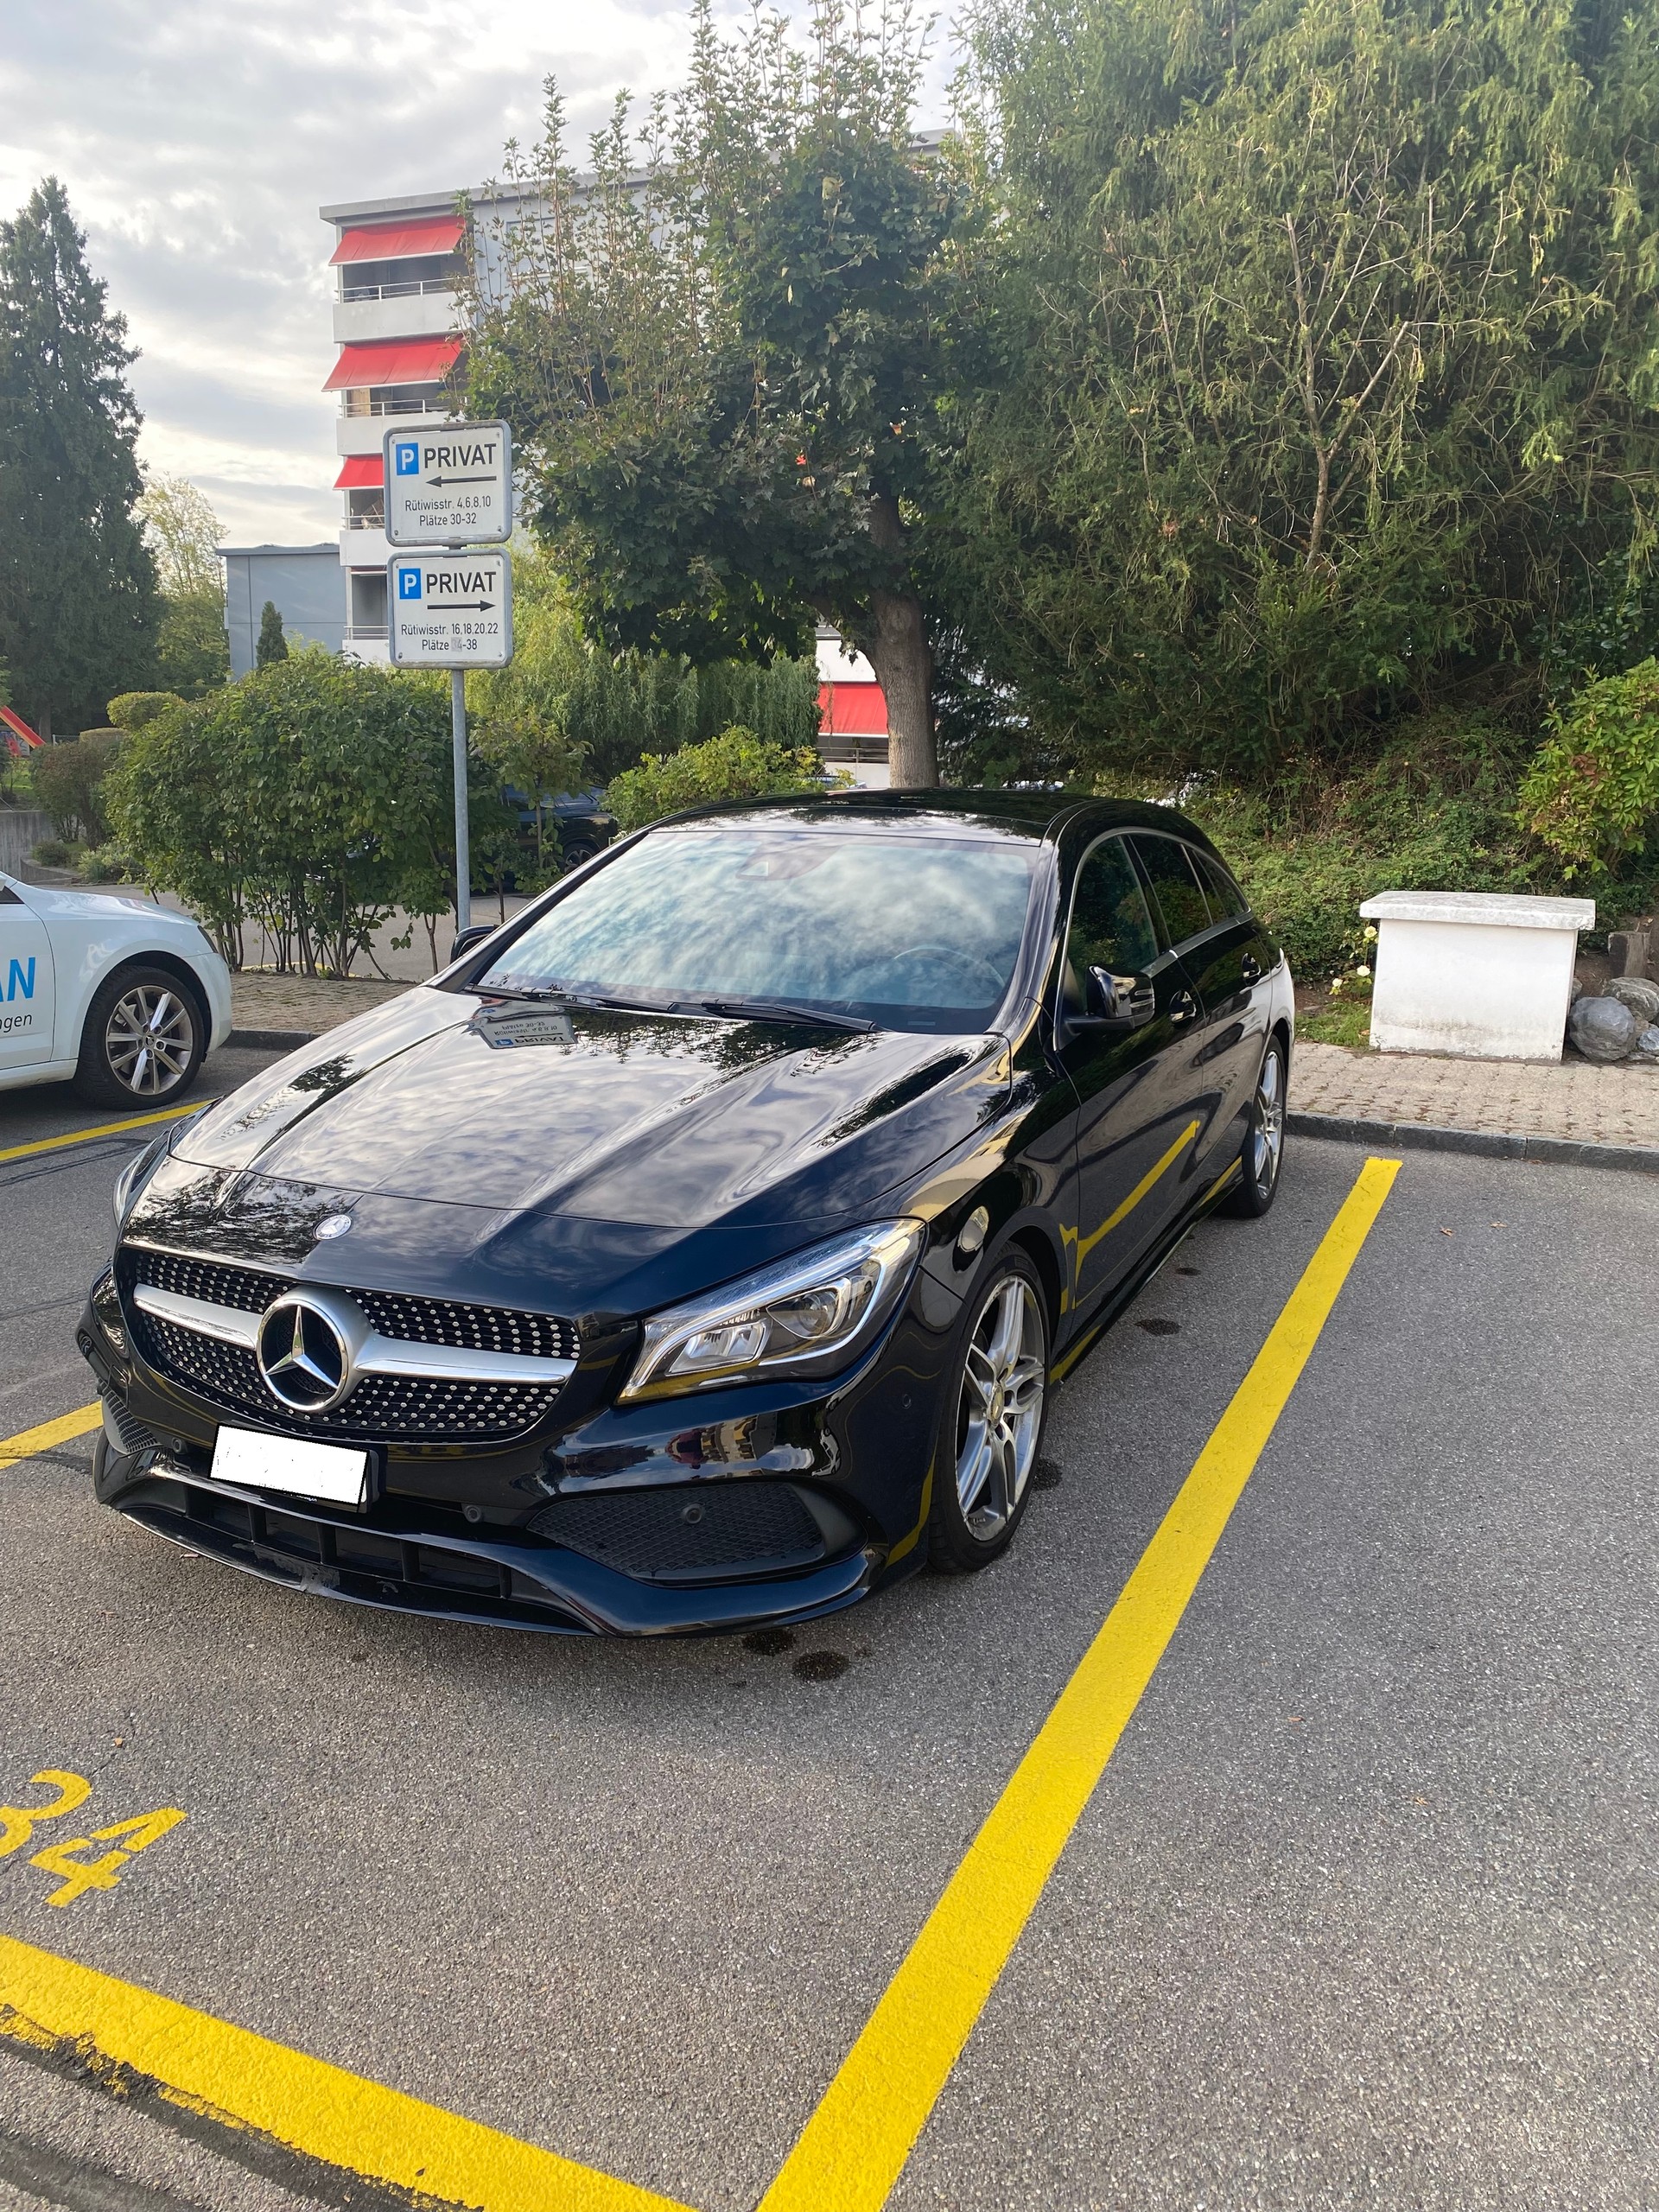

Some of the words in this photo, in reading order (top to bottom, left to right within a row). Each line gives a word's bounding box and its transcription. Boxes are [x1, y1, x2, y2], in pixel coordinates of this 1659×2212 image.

[401, 448, 415, 471] P
[424, 443, 497, 468] PRIVAT
[405, 499, 454, 512] Rütiwisstr.
[457, 495, 491, 509] 4,6,8,10
[419, 515, 448, 526] Plätze
[450, 512, 476, 524] 30-32
[404, 574, 417, 595] P
[426, 571, 497, 594] PRIVAT
[401, 623, 448, 635] Rütiwisstr.
[422, 639, 449, 651] Plätze
[0, 957, 35, 1002] N
[0, 1014, 32, 1033] gen
[0, 1769, 188, 1908] 34
